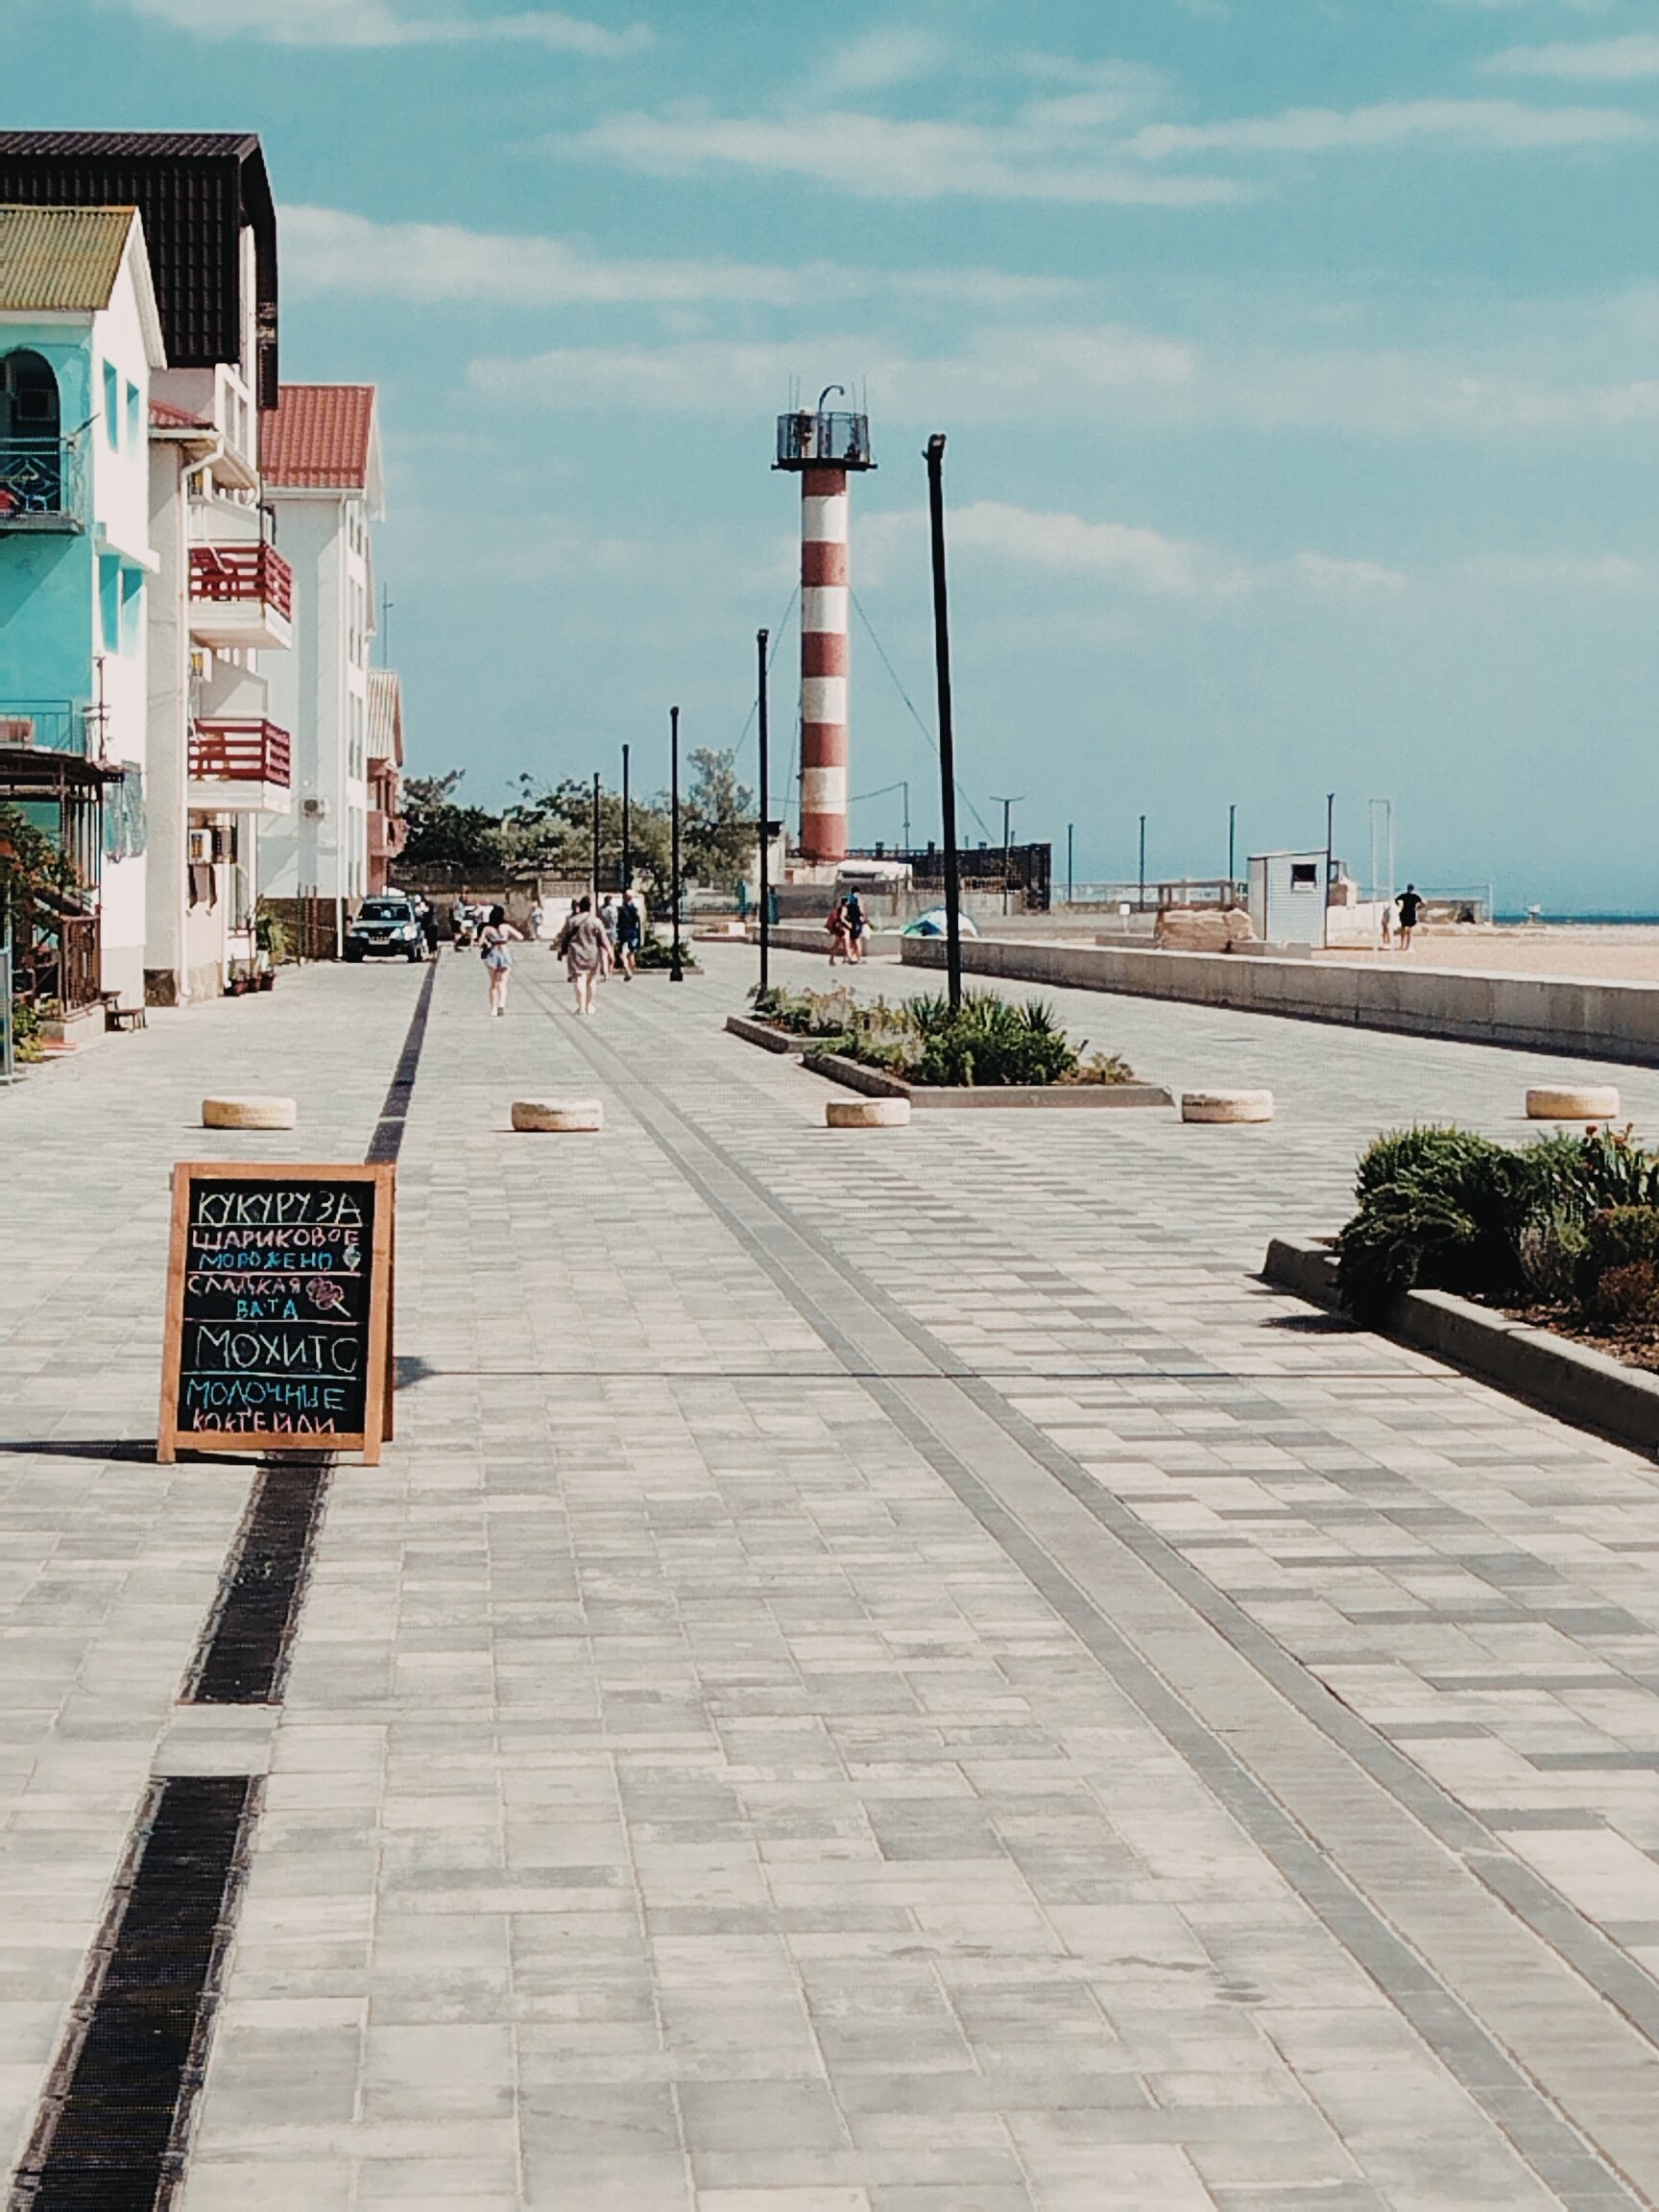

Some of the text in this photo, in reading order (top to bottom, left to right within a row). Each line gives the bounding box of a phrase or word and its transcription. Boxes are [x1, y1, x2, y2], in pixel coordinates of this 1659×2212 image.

[198, 1190, 363, 1226] КУКУРУЗА
[192, 1227, 360, 1251] ШАРИКОВОЕ
[187, 1275, 301, 1296] СЛАДКАЯ
[236, 1298, 299, 1321] ВАТА
[186, 1379, 348, 1411] МОЛОЧНЫЕ
[192, 1407, 336, 1433] КОКТЕЙЛИ
